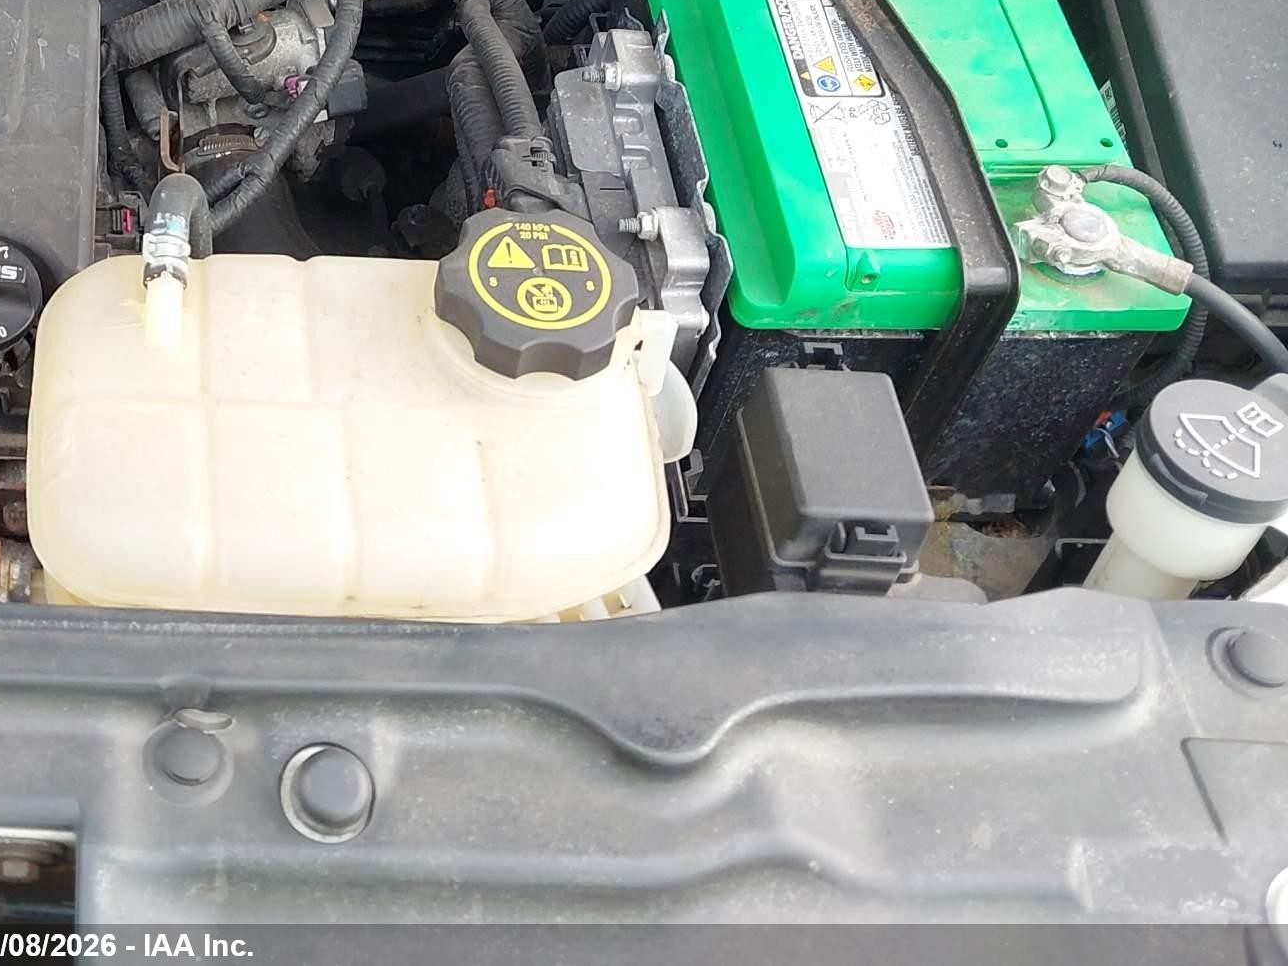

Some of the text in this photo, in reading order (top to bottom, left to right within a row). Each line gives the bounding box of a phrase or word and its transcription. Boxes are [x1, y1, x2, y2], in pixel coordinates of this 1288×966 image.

[903, 131, 920, 156] BATTERY
[515, 223, 550, 232] 140 kPa
[533, 232, 548, 240] PSI
